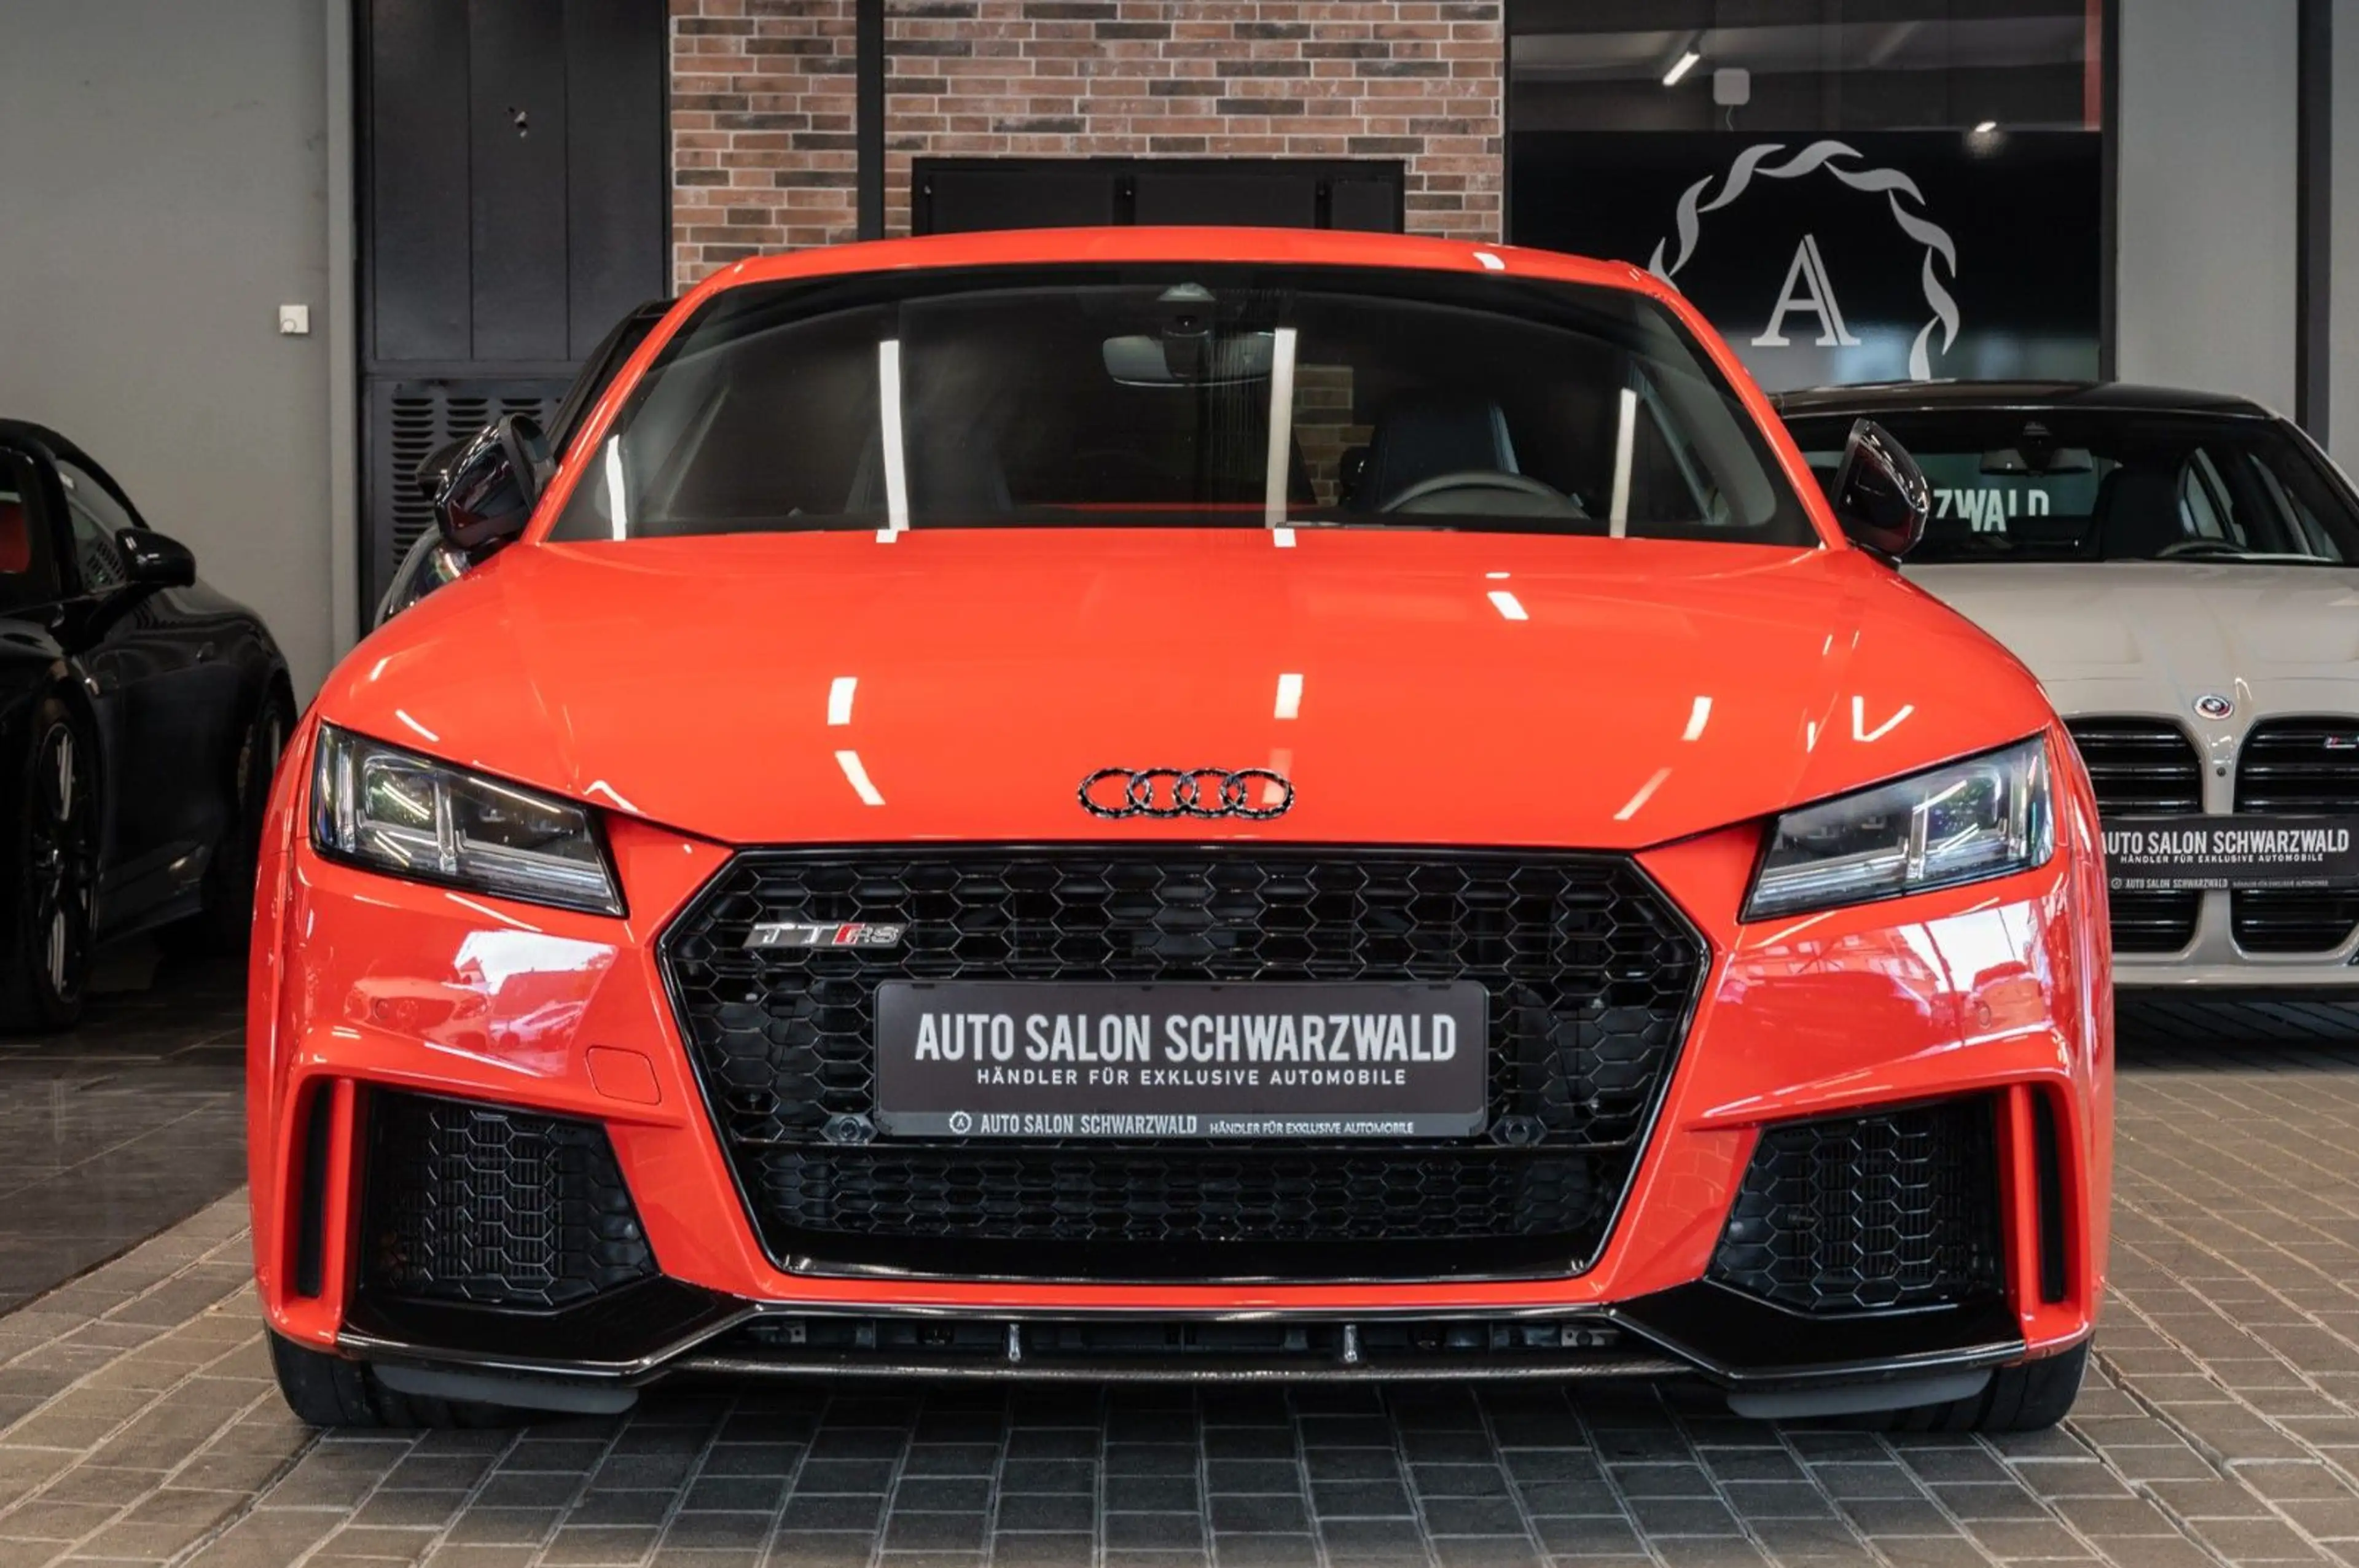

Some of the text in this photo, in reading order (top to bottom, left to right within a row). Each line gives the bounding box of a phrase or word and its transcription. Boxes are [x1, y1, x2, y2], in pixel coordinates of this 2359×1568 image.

[1751, 234, 1861, 346] A
[2148, 831, 2207, 854] SALON
[2213, 829, 2349, 854] SCHWARZWALD
[2121, 852, 2323, 864] HÄNDLER FÜR EXKLUSIVE AUTOMOBILE
[915, 1013, 1456, 1063] AUTO SALON SCHWARZWALD
[977, 1066, 1406, 1085] HÄNDLER FÜR EXKLUSIVE AUTOMOBILE
[981, 1114, 1414, 1134] AUTO SALON SCHWARZWALD HÄNDLER FÜR EXKLUSIVE AUTOMOBILE
